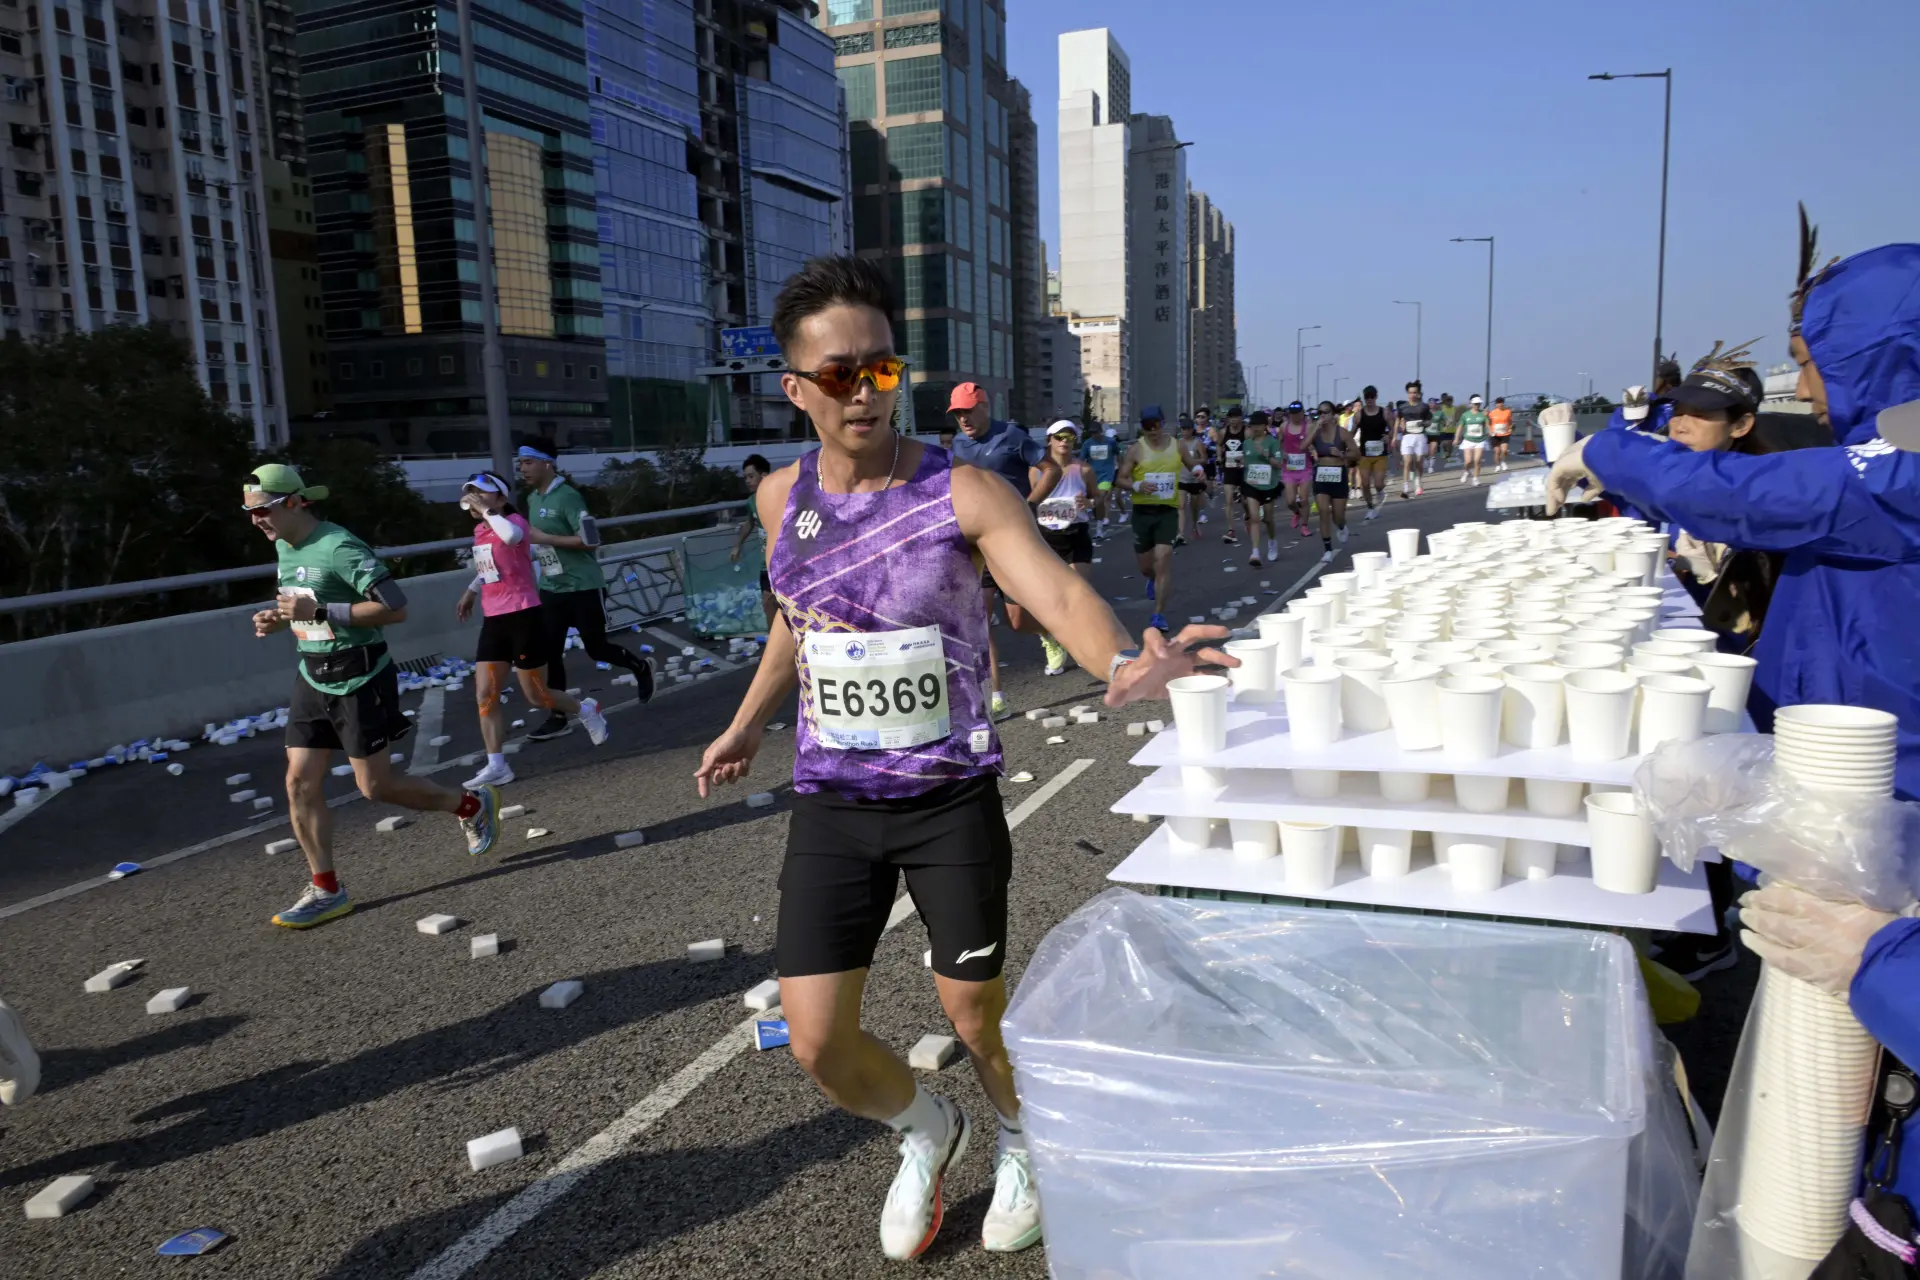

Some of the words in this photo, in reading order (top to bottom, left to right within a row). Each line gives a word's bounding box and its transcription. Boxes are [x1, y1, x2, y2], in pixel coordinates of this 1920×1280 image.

[1154, 172, 1171, 323] 港島太平洋酒店
[817, 672, 941, 717] E6369
